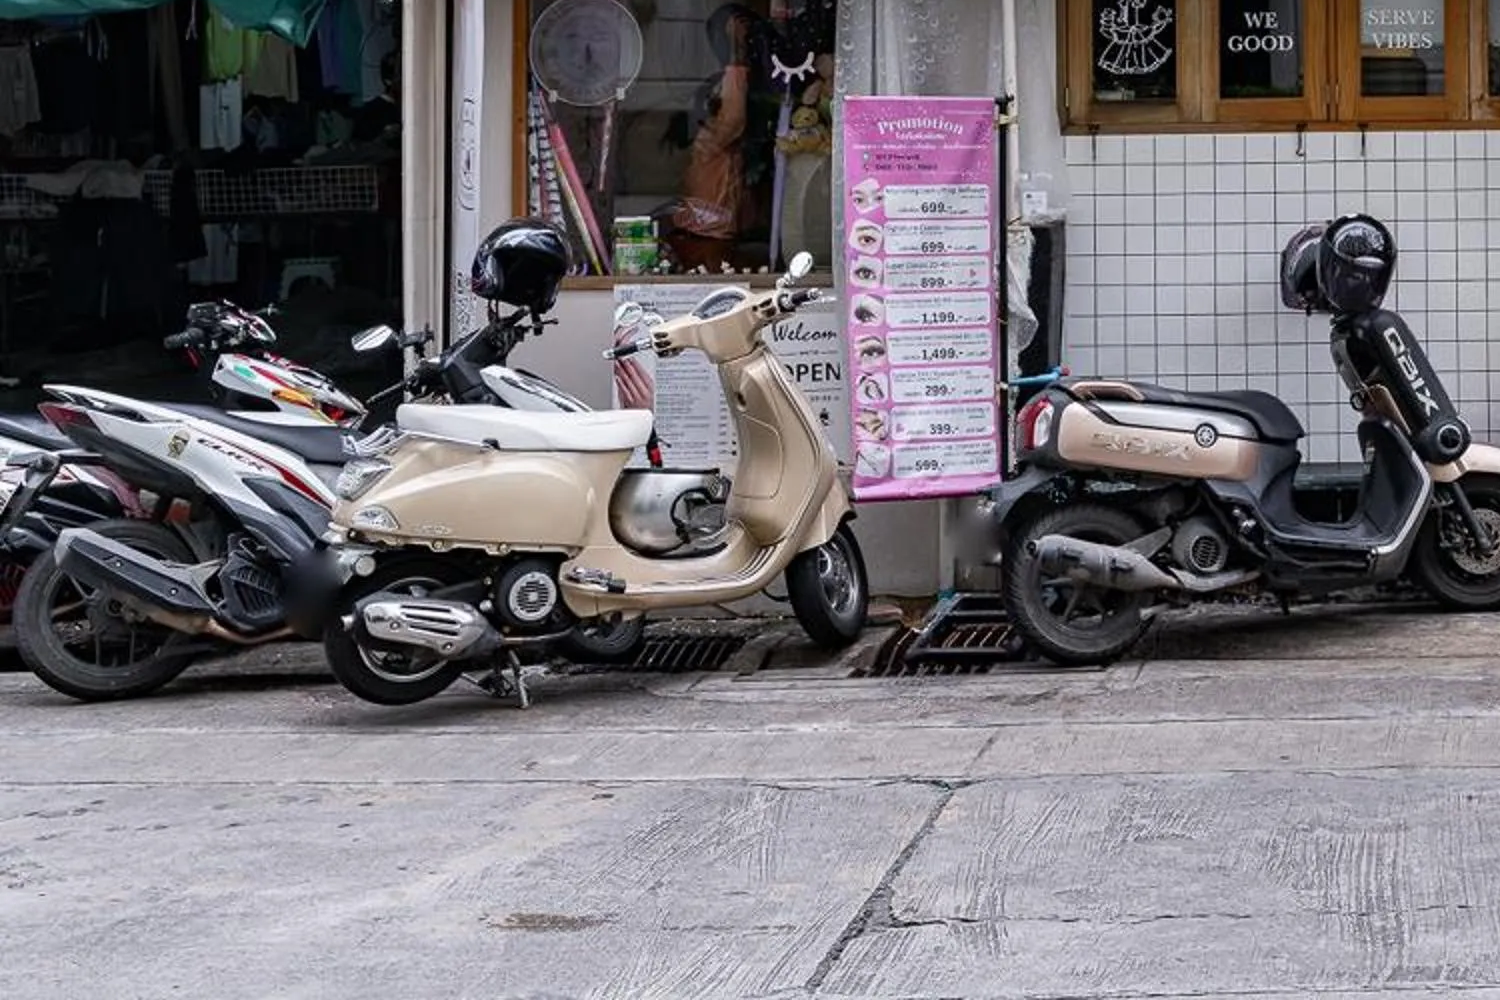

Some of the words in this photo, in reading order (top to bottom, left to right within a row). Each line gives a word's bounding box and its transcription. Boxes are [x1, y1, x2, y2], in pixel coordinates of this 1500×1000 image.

[1243, 11, 1278, 29] WE
[1367, 9, 1435, 25] SERVE
[1227, 35, 1294, 52] GOOD
[1372, 32, 1433, 49] VIBES
[877, 115, 964, 136] Promotion
[772, 322, 838, 342] Welcom
[1383, 327, 1440, 417] QBIX
